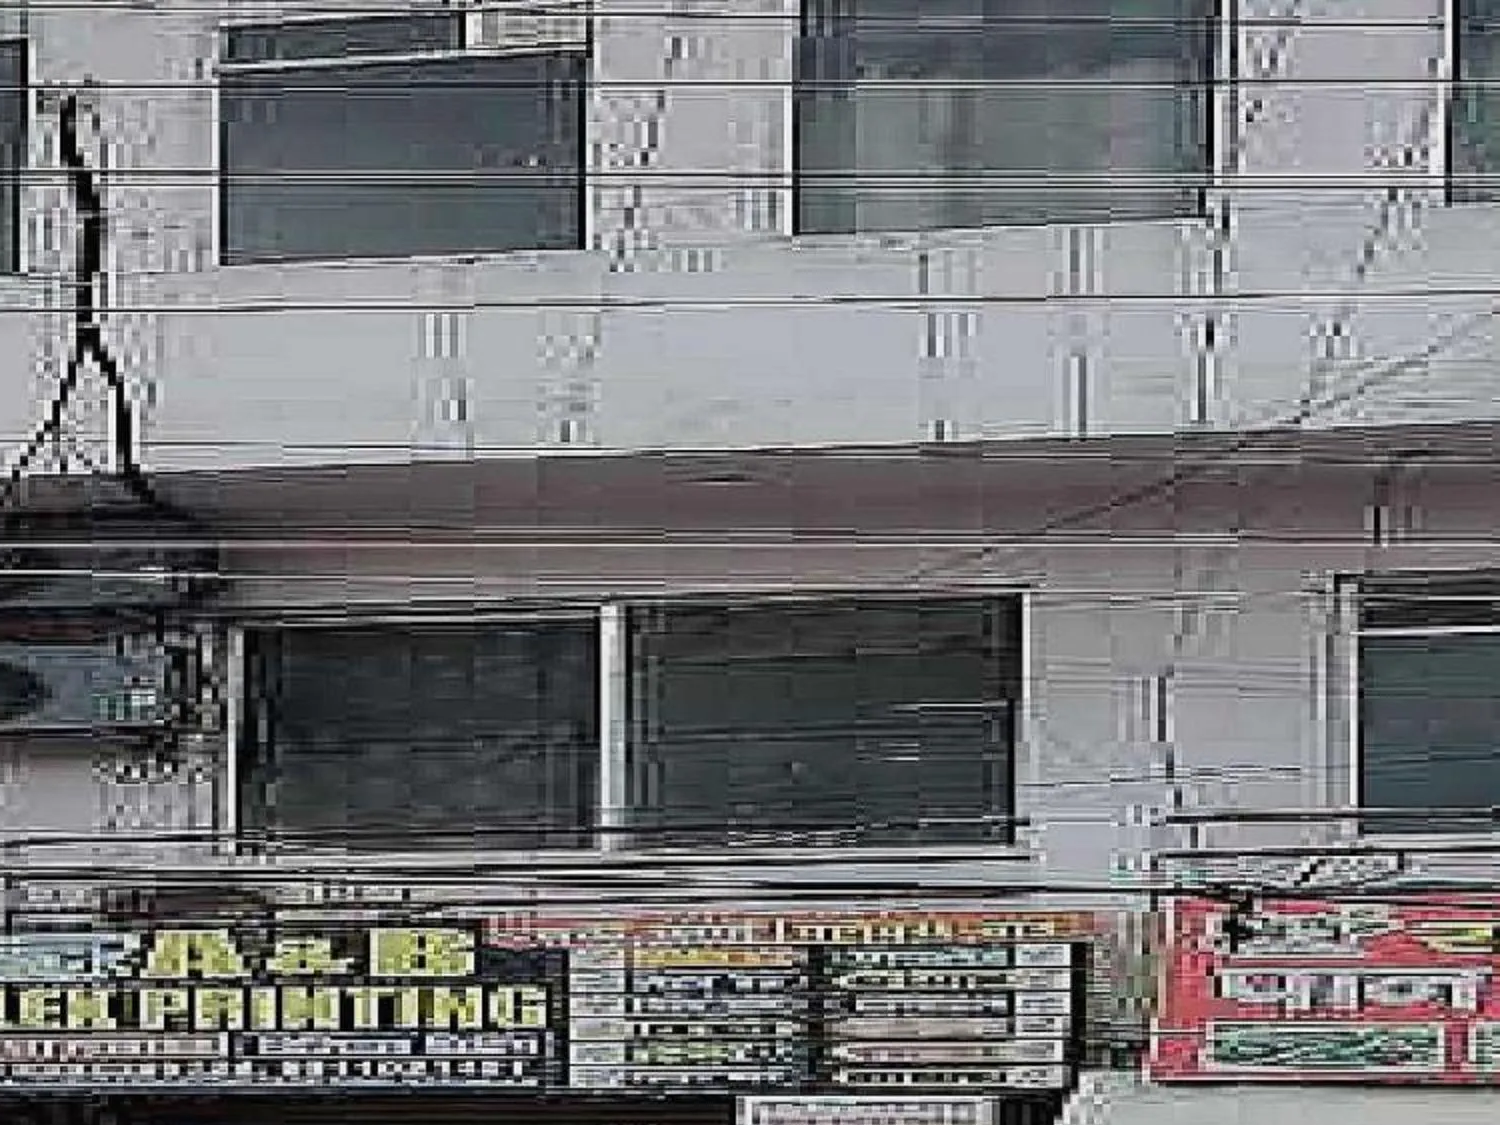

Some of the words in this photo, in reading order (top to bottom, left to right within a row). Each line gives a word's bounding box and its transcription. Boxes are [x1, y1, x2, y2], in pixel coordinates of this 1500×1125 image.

[144, 928, 250, 979] A
[368, 927, 476, 977] B
[139, 986, 548, 1030] PRINTING
